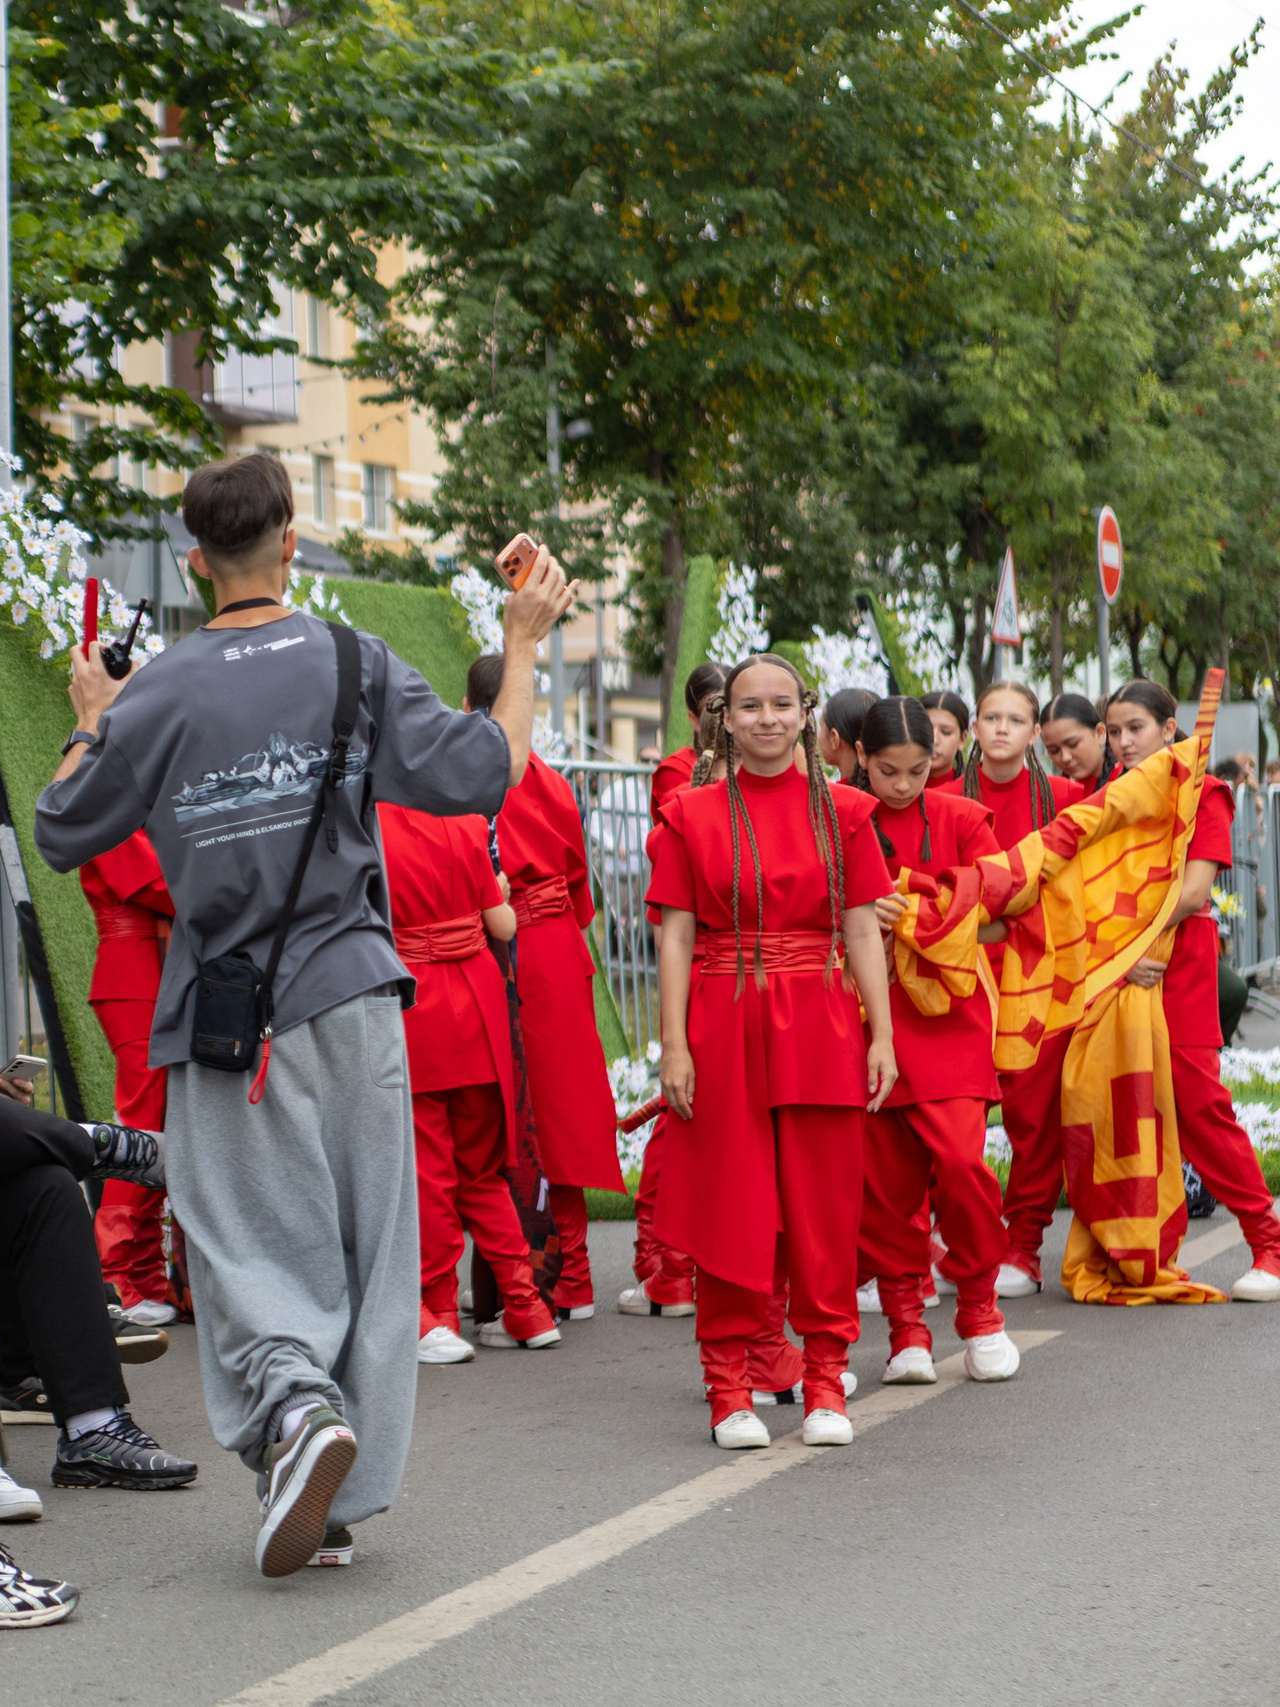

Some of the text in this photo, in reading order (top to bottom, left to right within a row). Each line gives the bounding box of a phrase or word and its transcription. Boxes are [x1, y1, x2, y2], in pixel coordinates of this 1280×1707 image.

[195, 838, 216, 848] LIGHT
[216, 834, 236, 843] YOUR
[236, 828, 255, 838] MIND
[261, 821, 292, 833] ELSAKOV
